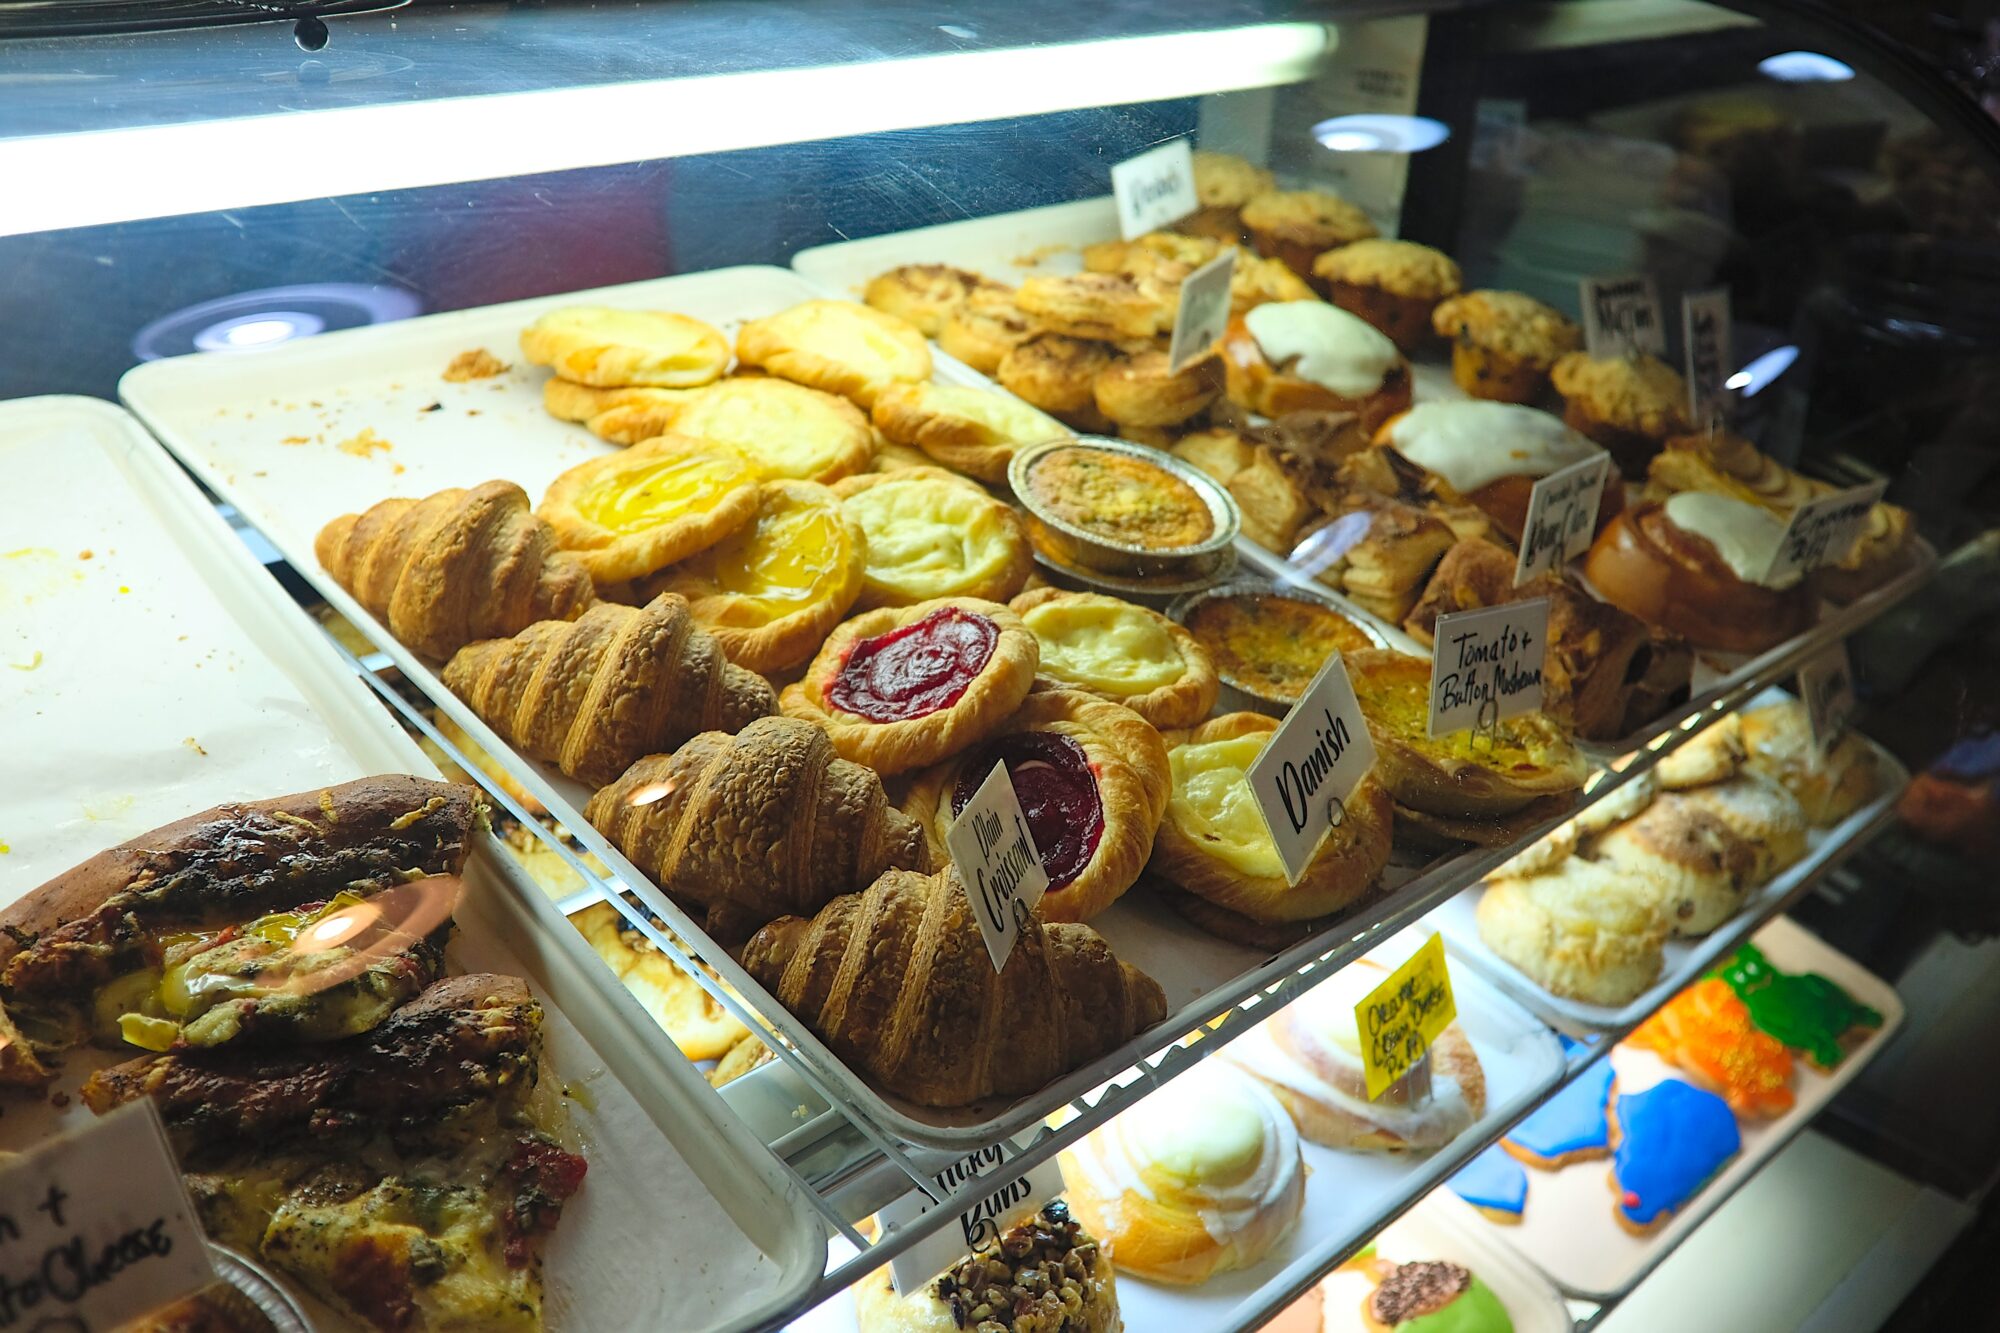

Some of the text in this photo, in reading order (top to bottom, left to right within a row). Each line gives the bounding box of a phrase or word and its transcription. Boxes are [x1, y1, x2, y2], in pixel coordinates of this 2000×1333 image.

[1453, 624, 1517, 669] Tomato
[1439, 668, 1489, 714] Button
[1275, 708, 1351, 835] Danish
[971, 808, 1004, 868] Plain
[977, 814, 1037, 934] Croissant
